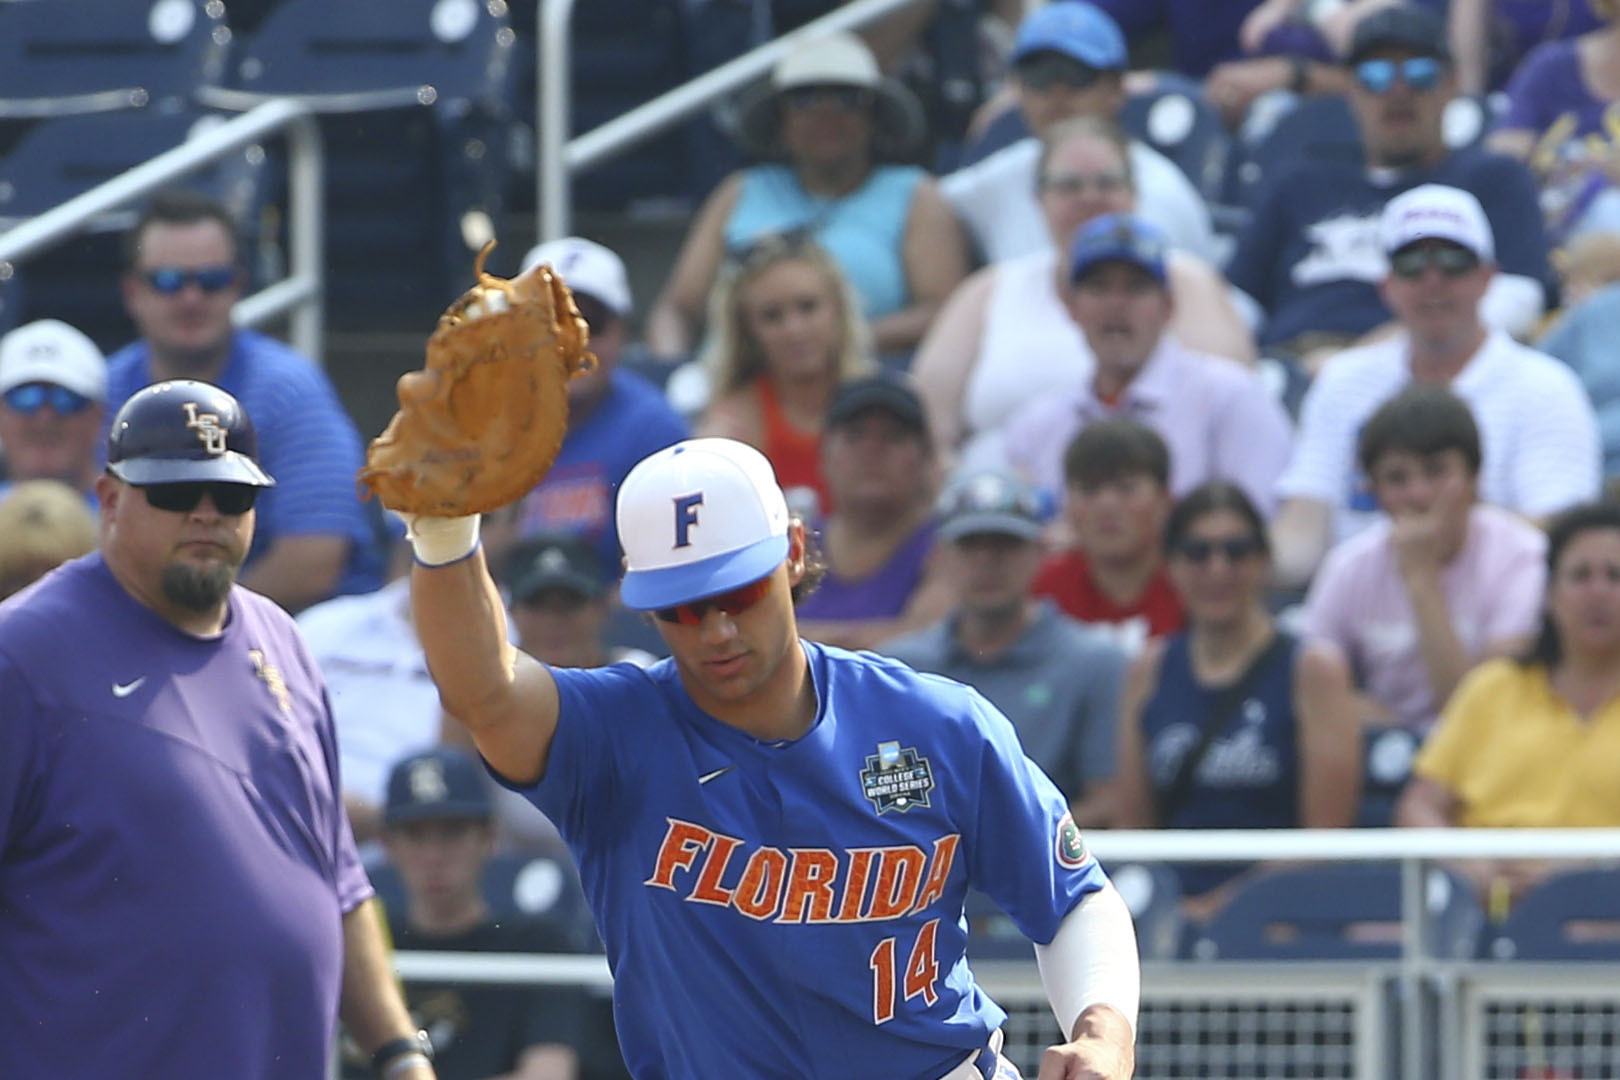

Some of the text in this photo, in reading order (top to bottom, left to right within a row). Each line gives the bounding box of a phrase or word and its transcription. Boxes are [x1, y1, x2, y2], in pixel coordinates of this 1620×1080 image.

[183, 402, 228, 454] LSU
[672, 490, 704, 550] F
[867, 783, 898, 797] WORLD
[899, 778, 930, 792] SERIES
[878, 770, 915, 785] COLLEGE
[643, 817, 962, 924] FLORIDA
[870, 918, 939, 1025] 14
